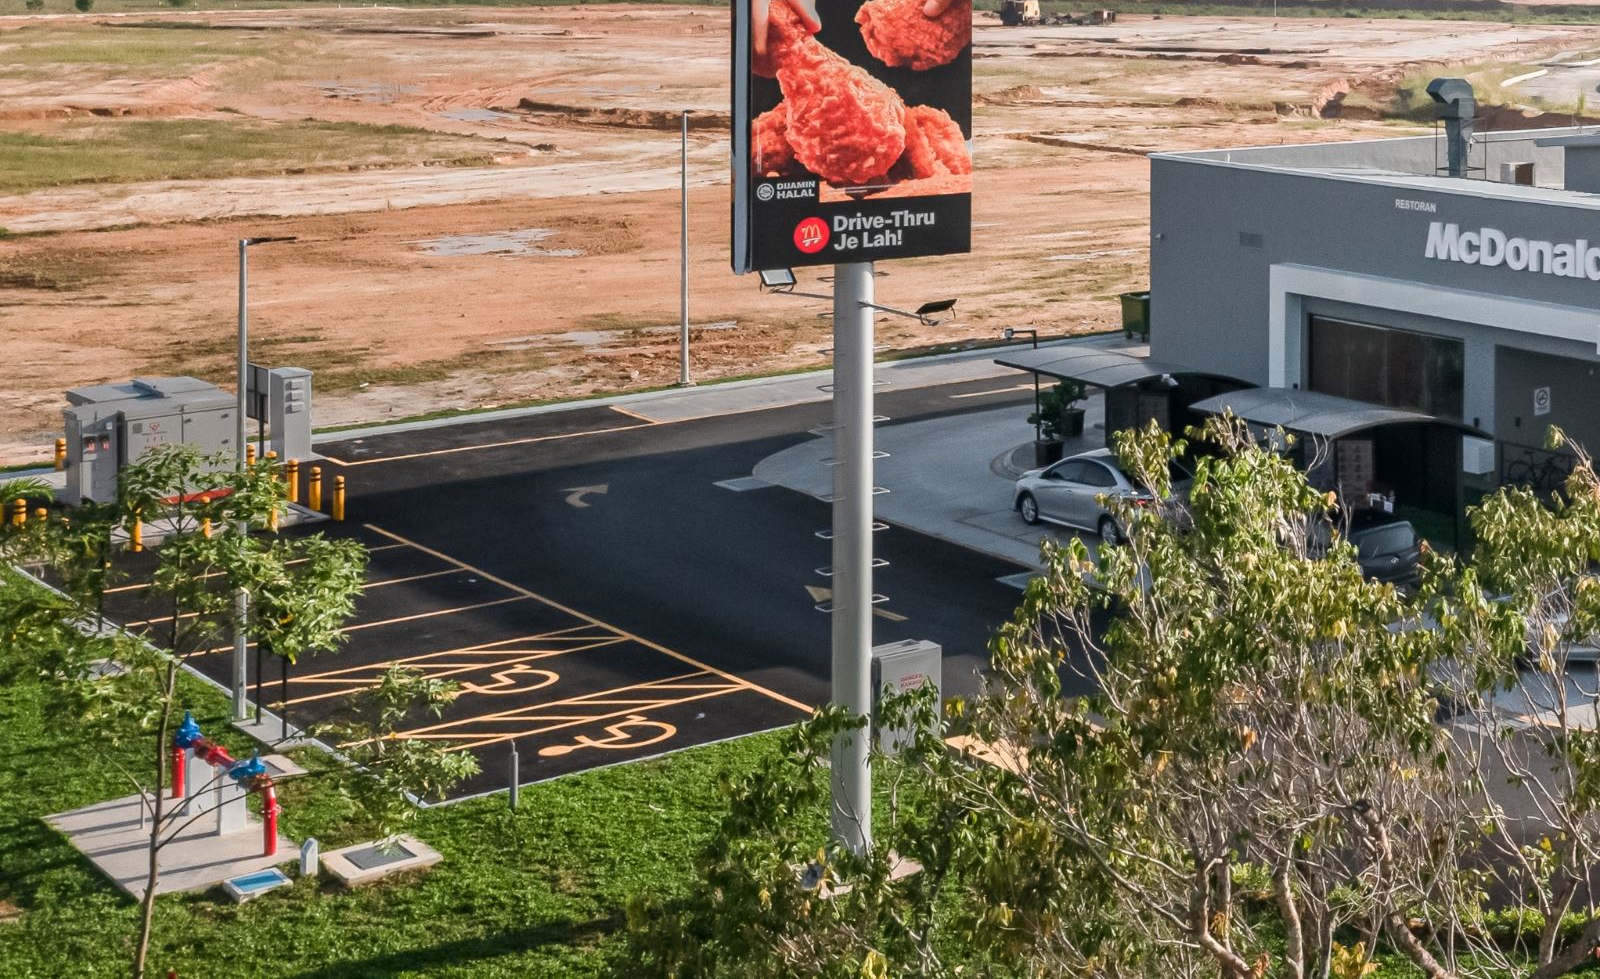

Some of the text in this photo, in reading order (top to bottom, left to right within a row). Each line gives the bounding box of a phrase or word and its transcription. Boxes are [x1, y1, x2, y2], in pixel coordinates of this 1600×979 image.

[776, 180, 816, 191] DIJAMIN
[776, 188, 815, 200] HALAL
[1394, 198, 1437, 214] RESTORAN
[833, 209, 935, 233] Drive-Thru
[833, 229, 903, 251] Je Lah!
